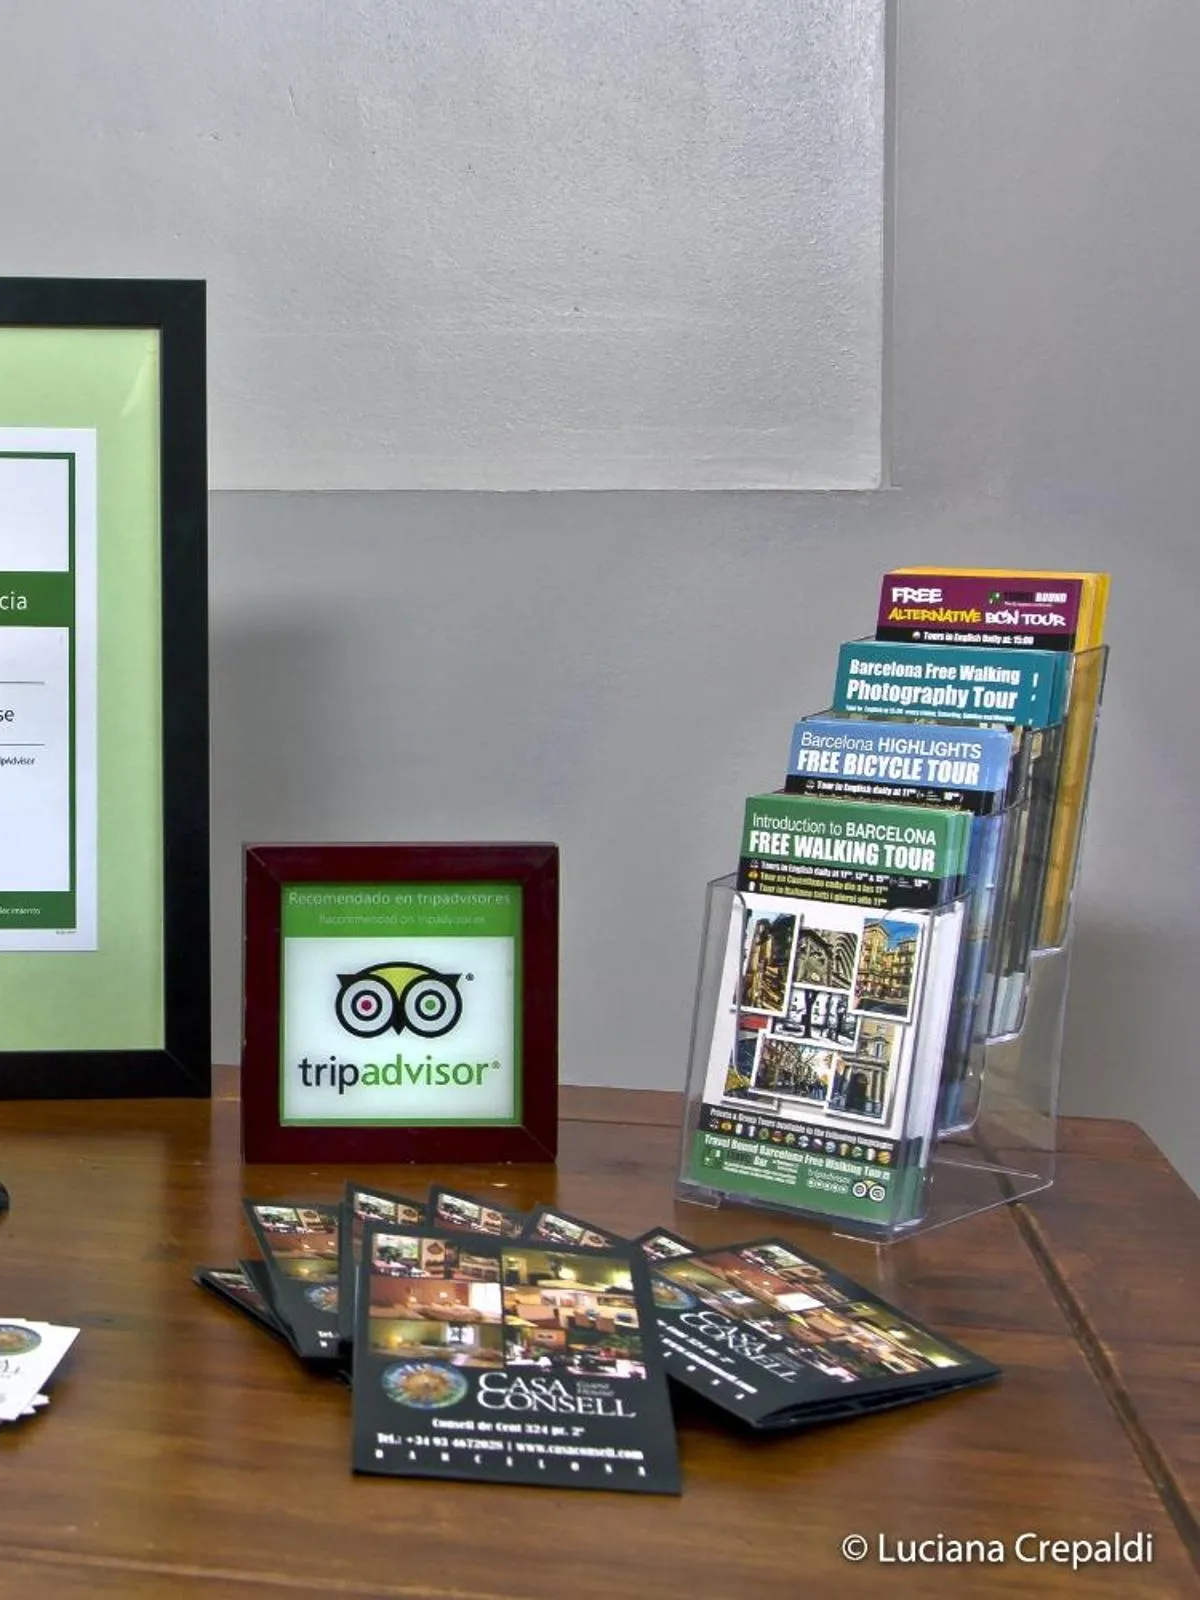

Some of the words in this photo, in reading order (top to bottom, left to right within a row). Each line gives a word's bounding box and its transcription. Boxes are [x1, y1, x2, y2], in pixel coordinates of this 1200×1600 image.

[891, 586, 944, 604] FREE
[888, 606, 983, 624] ALTERNATIVE
[1020, 612, 1067, 627] TOUR
[923, 631, 945, 641] Tours
[953, 633, 982, 644] English
[849, 658, 922, 679] Barcelona
[924, 663, 957, 680] Free
[959, 665, 1021, 686] Walking
[847, 679, 970, 708] Photography
[972, 686, 1018, 710] Tour
[801, 731, 874, 752] Barcelona
[877, 736, 982, 760] HIGHLIGHTS
[797, 749, 841, 775] FREE
[842, 752, 923, 782] BICYCLE
[926, 758, 980, 785] TOUR
[816, 780, 835, 791] Tour
[844, 783, 871, 794] English
[873, 785, 892, 797] daily
[753, 813, 826, 836] Introduction
[830, 820, 842, 836] to
[845, 821, 937, 847] BARCELONA
[749, 829, 790, 858] FREE
[793, 834, 880, 867] WALKING
[882, 844, 936, 874] TOUR
[288, 891, 391, 906] Recomendado
[394, 894, 413, 905] en
[704, 1133, 731, 1149] Travel
[730, 1137, 758, 1154] Bound
[758, 1142, 804, 1163] Barcelona
[804, 1154, 826, 1168] Free
[825, 1157, 863, 1176] Walking
[862, 1164, 891, 1181] Tours
[478, 1371, 569, 1398] CASA
[476, 1386, 637, 1418] CONSELL
[431, 1417, 475, 1432] Consell
[476, 1420, 493, 1432] de
[495, 1420, 522, 1433] Cent
[524, 1422, 549, 1435] 324
[405, 1434, 430, 1447] +34
[432, 1435, 449, 1448] 93
[515, 1441, 645, 1461] www.casaconsell.com
